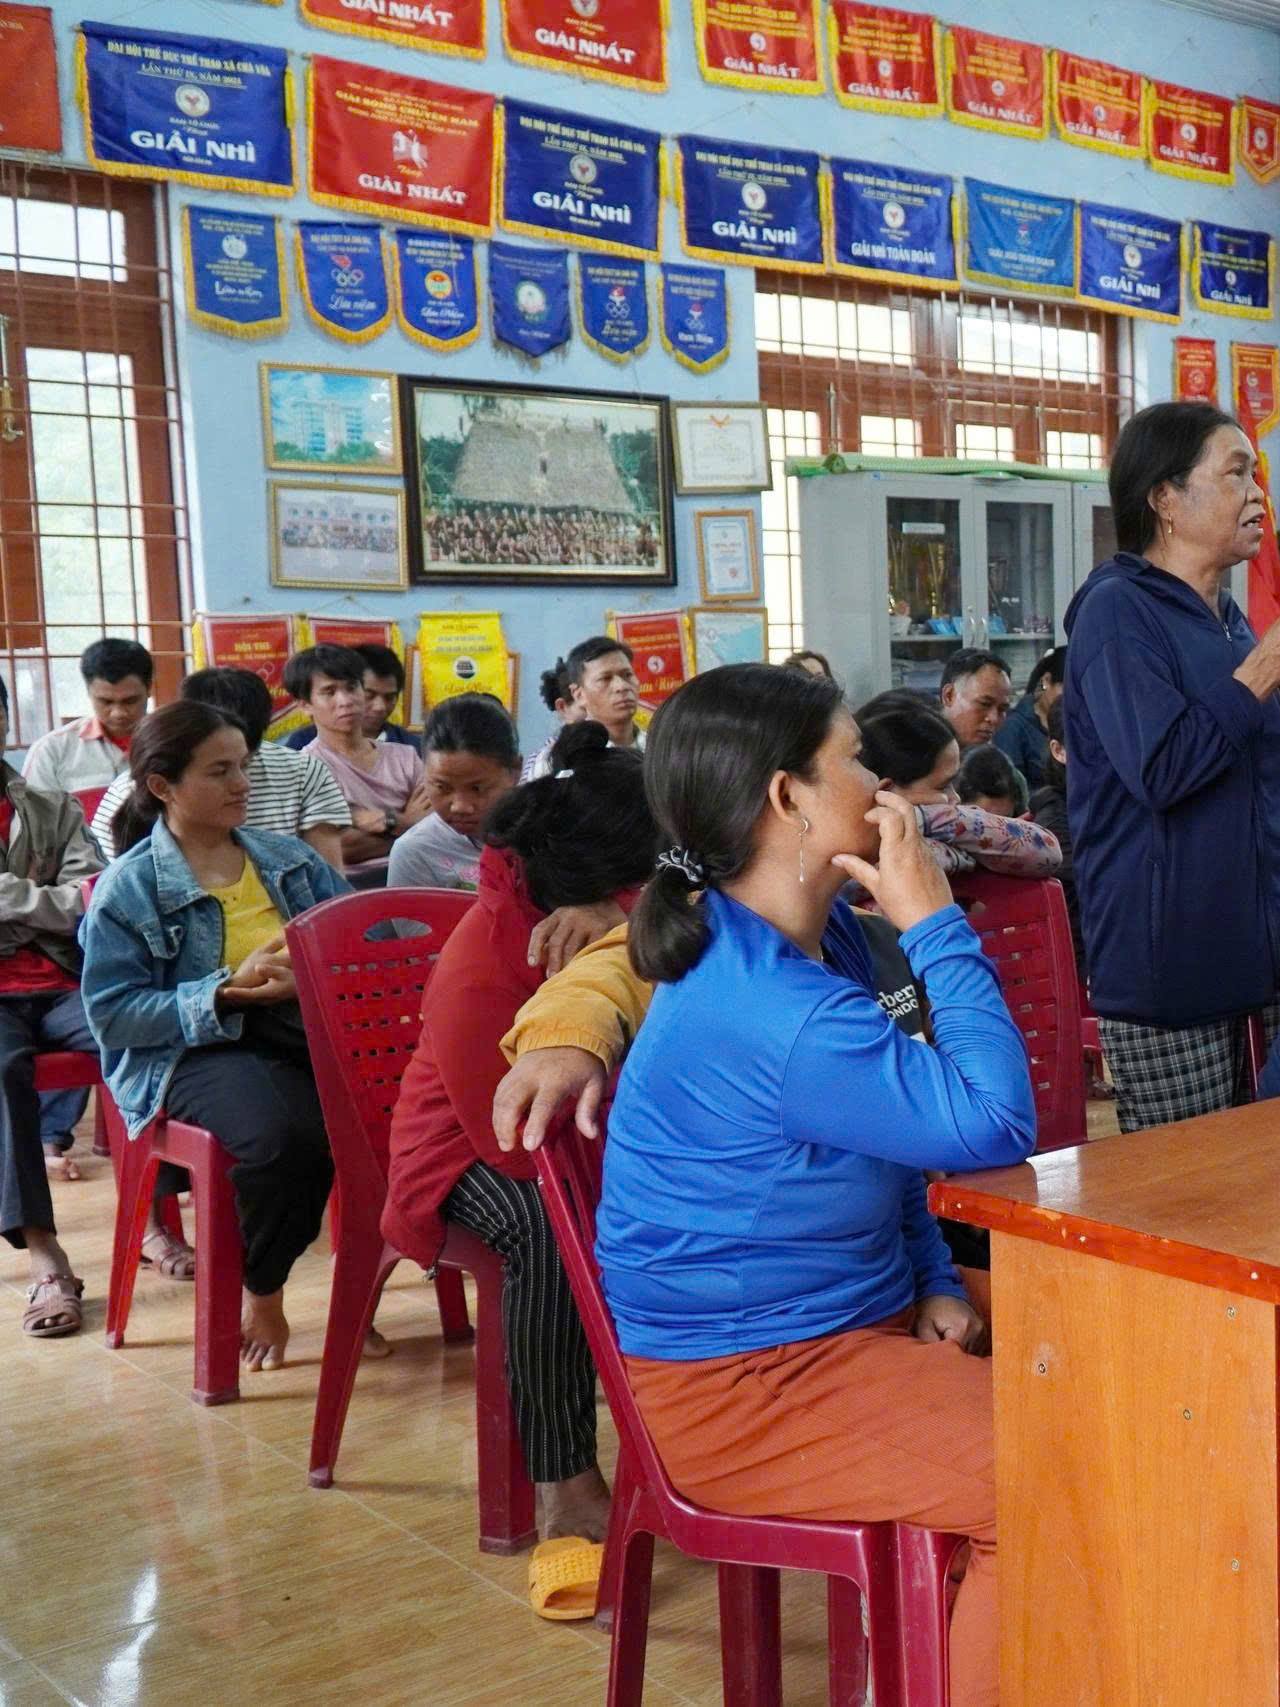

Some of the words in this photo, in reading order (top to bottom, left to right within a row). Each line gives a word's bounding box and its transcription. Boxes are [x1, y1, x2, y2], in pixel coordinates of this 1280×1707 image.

[535, 28, 575, 50] GIẢI
[724, 57, 753, 72] GIẢI
[130, 129, 197, 154] GIẢI
[206, 140, 256, 163] NHÌ
[358, 173, 402, 194] GIẢI
[407, 185, 467, 205] NHẤT
[533, 191, 584, 215] GIẢI
[591, 203, 630, 225] NHÌ
[712, 219, 757, 241] GIẢI
[763, 228, 797, 245] NHÌ
[1099, 275, 1132, 293] GIẢI
[1135, 283, 1161, 299] NHÌ
